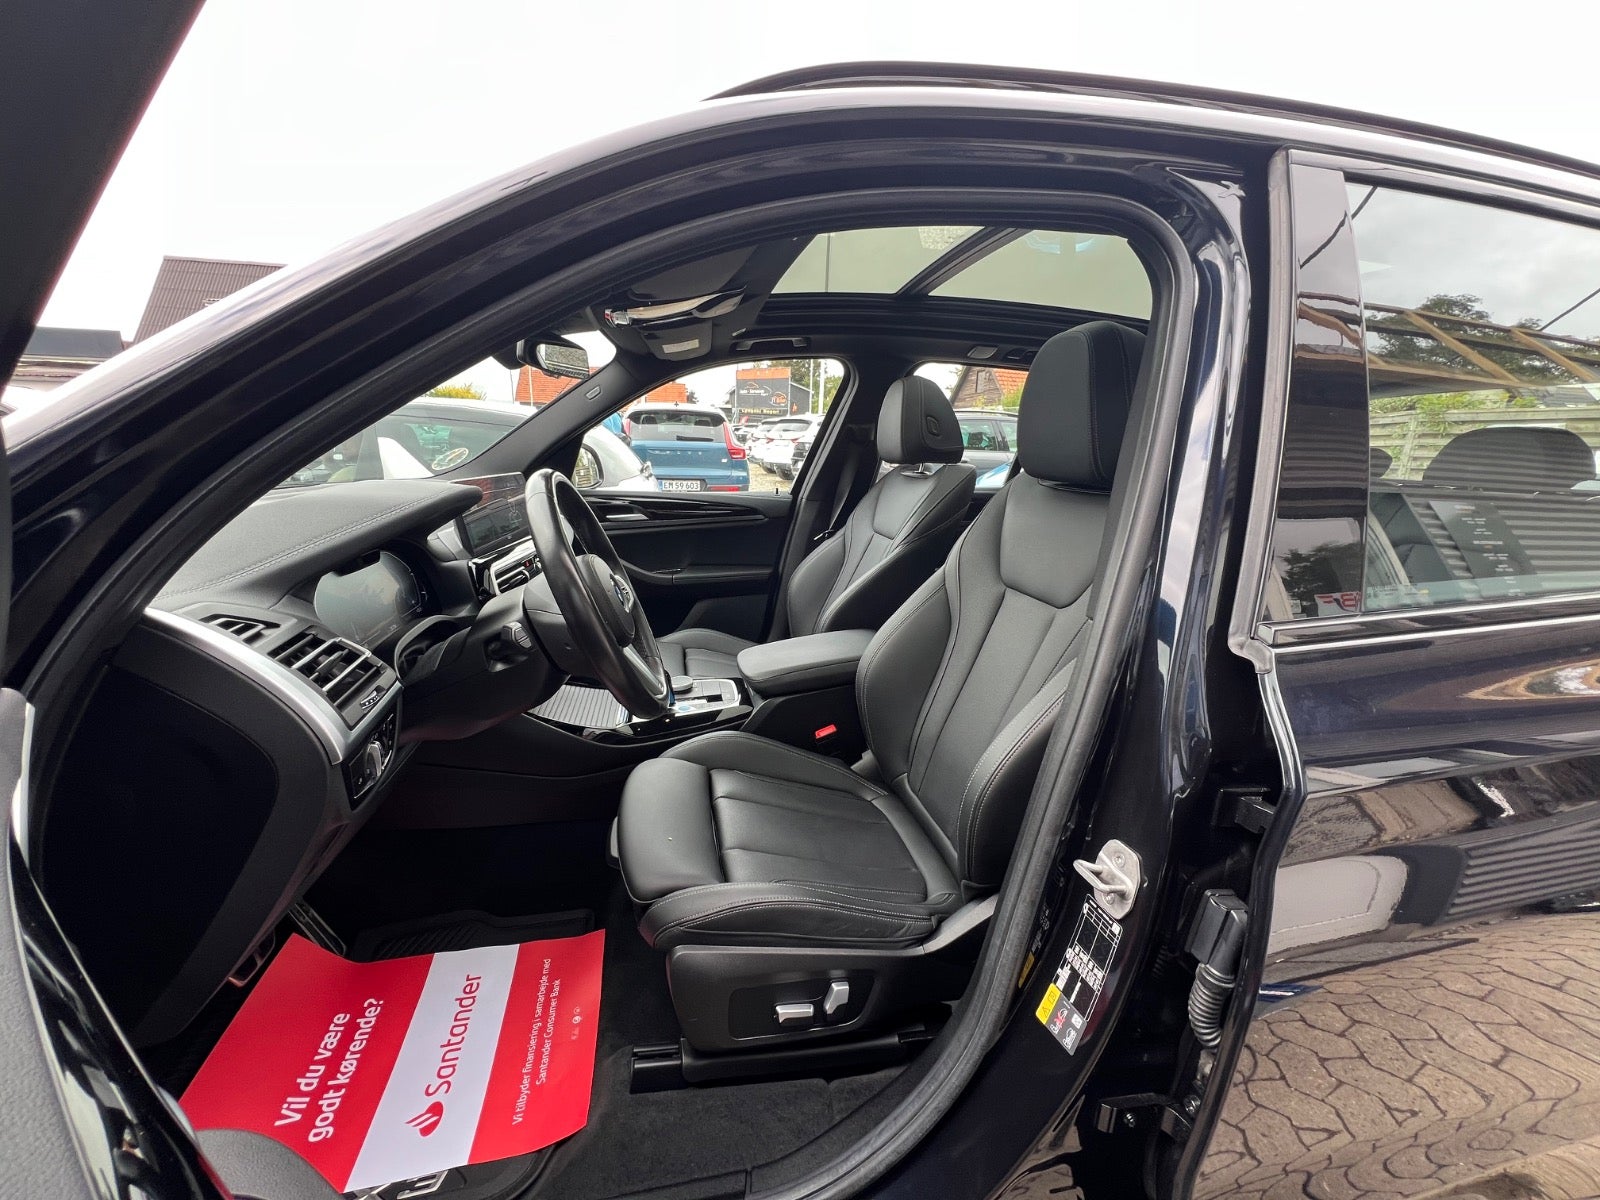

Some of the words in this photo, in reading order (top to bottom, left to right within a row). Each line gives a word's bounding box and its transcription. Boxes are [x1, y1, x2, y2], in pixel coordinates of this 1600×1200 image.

[674, 481, 684, 489] 59
[685, 481, 699, 489] 603
[542, 958, 552, 974] med
[535, 975, 549, 1018] samarbejde
[550, 979, 561, 998] Bank
[424, 973, 482, 1098] Santander
[543, 998, 557, 1038] Consumer
[522, 1022, 542, 1074] finansiering
[536, 1039, 552, 1085] Santander
[274, 1096, 311, 1127] Vil
[296, 1064, 326, 1092] du
[313, 1013, 351, 1061] være
[307, 1088, 346, 1143] godt
[327, 998, 384, 1086] kørende?
[515, 1074, 531, 1112] tilbyder
[511, 1113, 524, 1126] Vi
